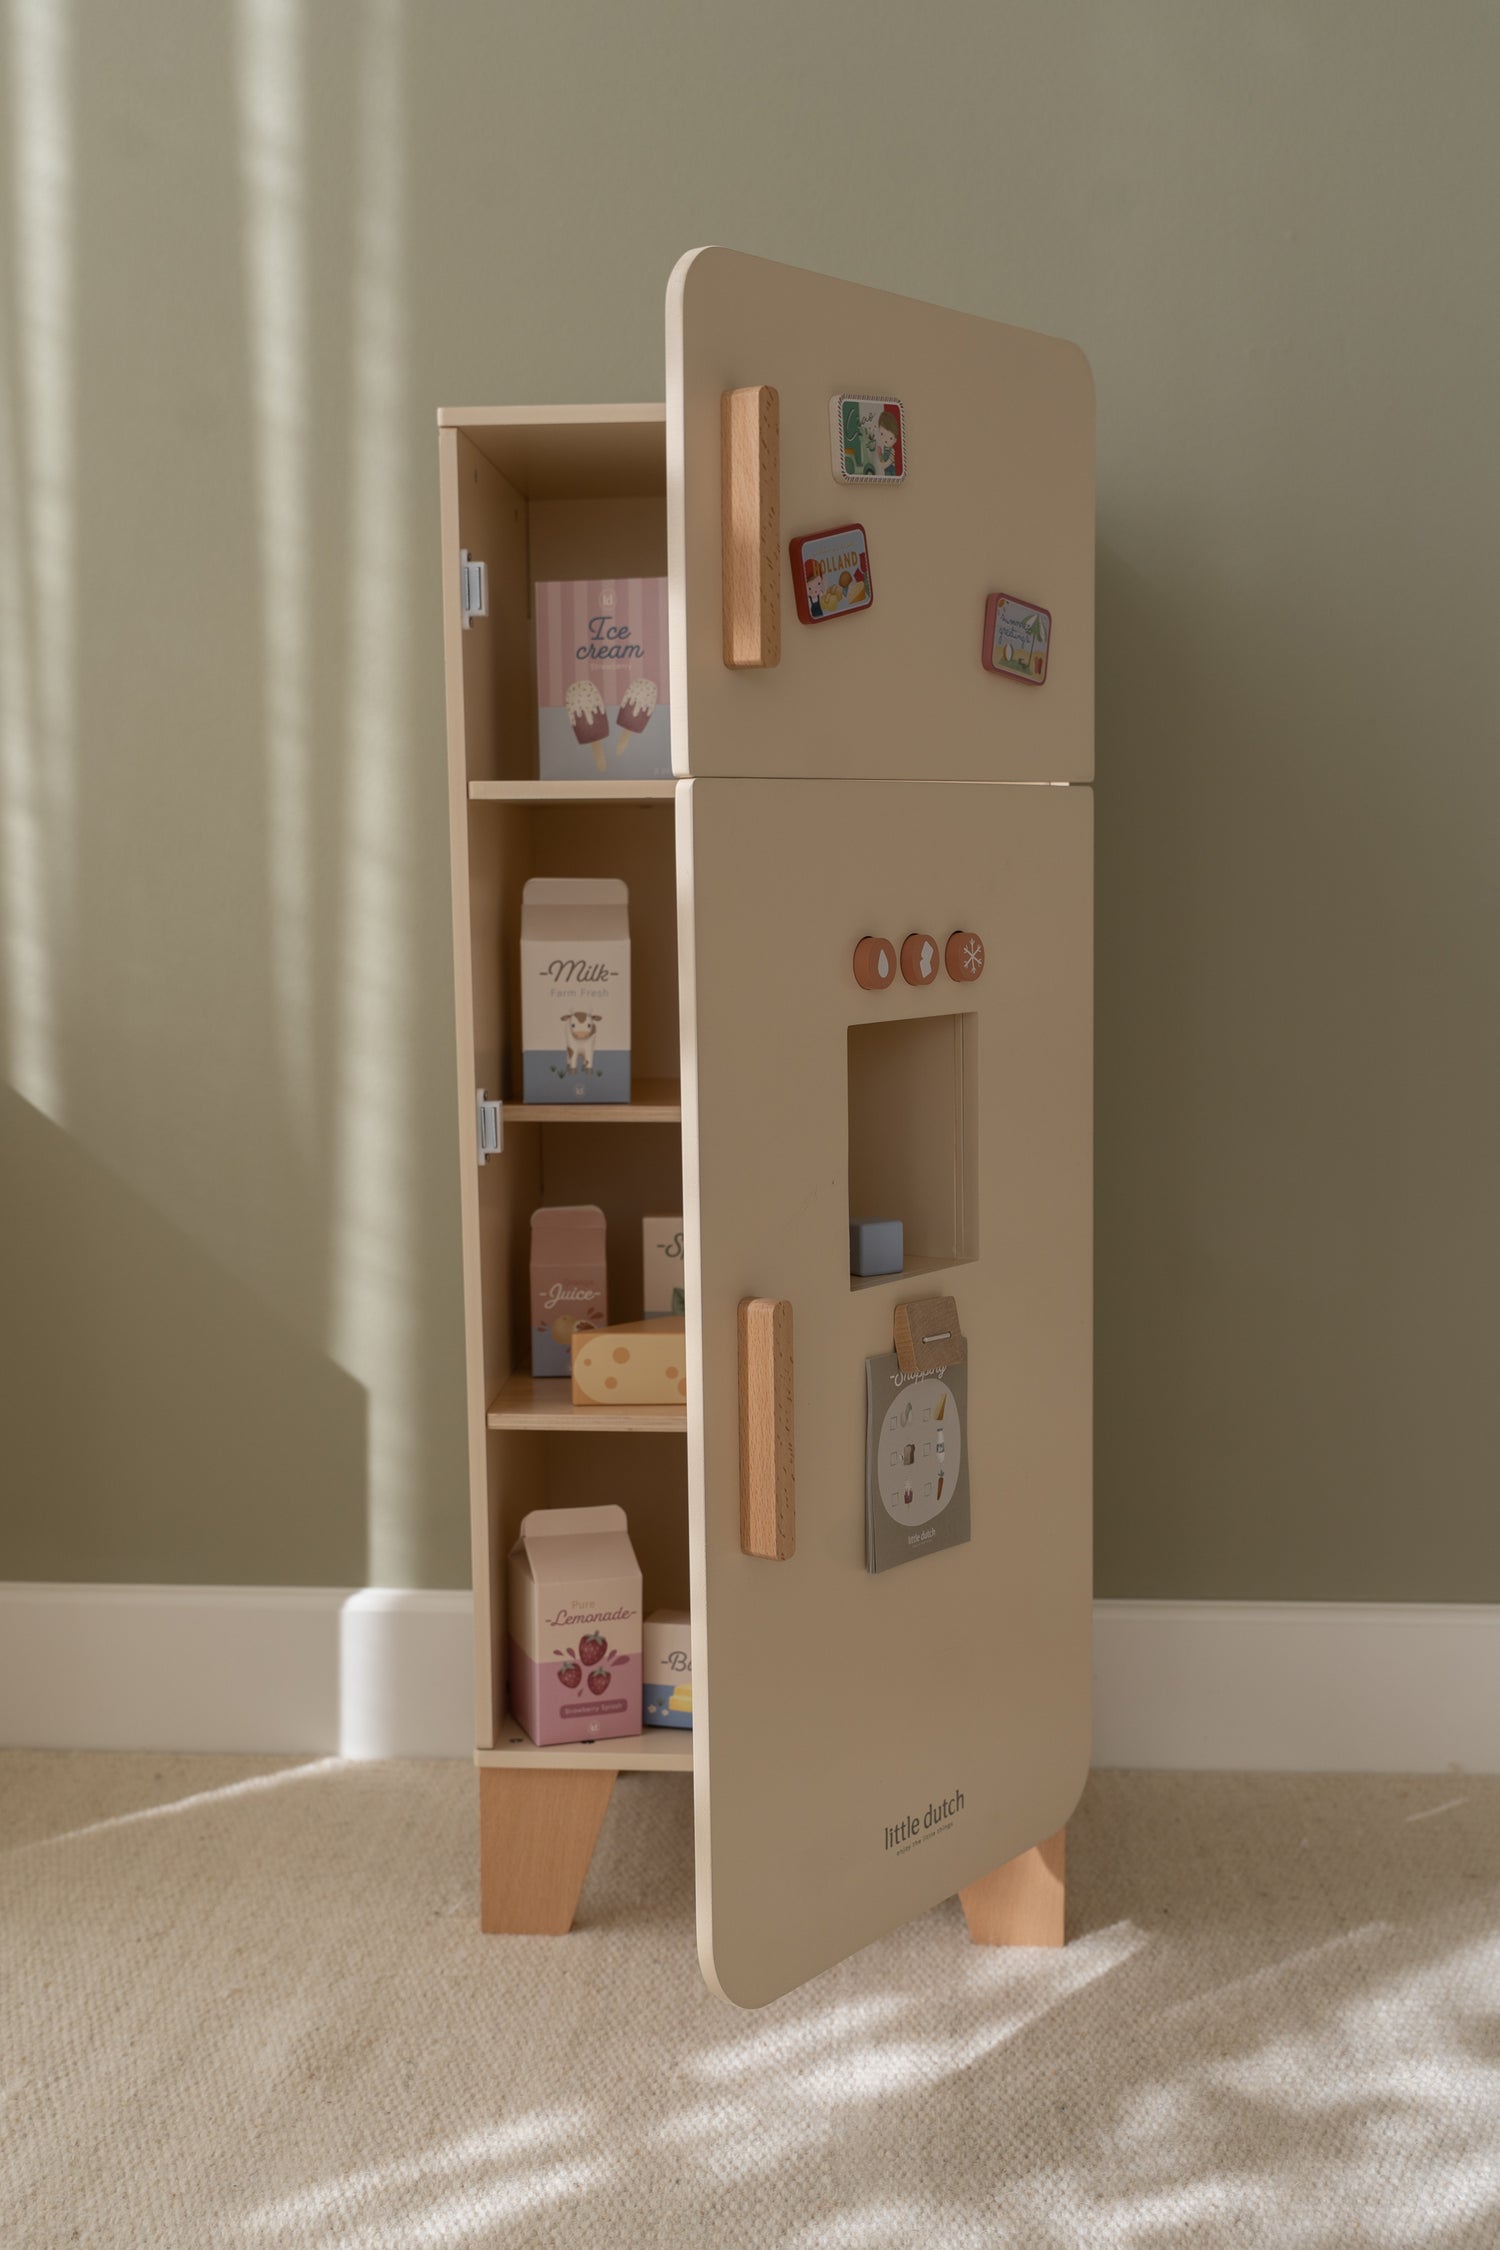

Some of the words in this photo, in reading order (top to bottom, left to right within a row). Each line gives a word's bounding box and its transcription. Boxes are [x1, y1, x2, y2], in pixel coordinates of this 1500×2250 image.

[811, 551, 858, 577] HOLLAND
[588, 616, 631, 641] Ice
[575, 643, 645, 660] cream
[550, 988, 577, 998] Farm
[580, 988, 609, 998] Fresh
[571, 1600, 596, 1609] Pure
[884, 1815, 920, 1851] little
[923, 1789, 965, 1829] dutch
